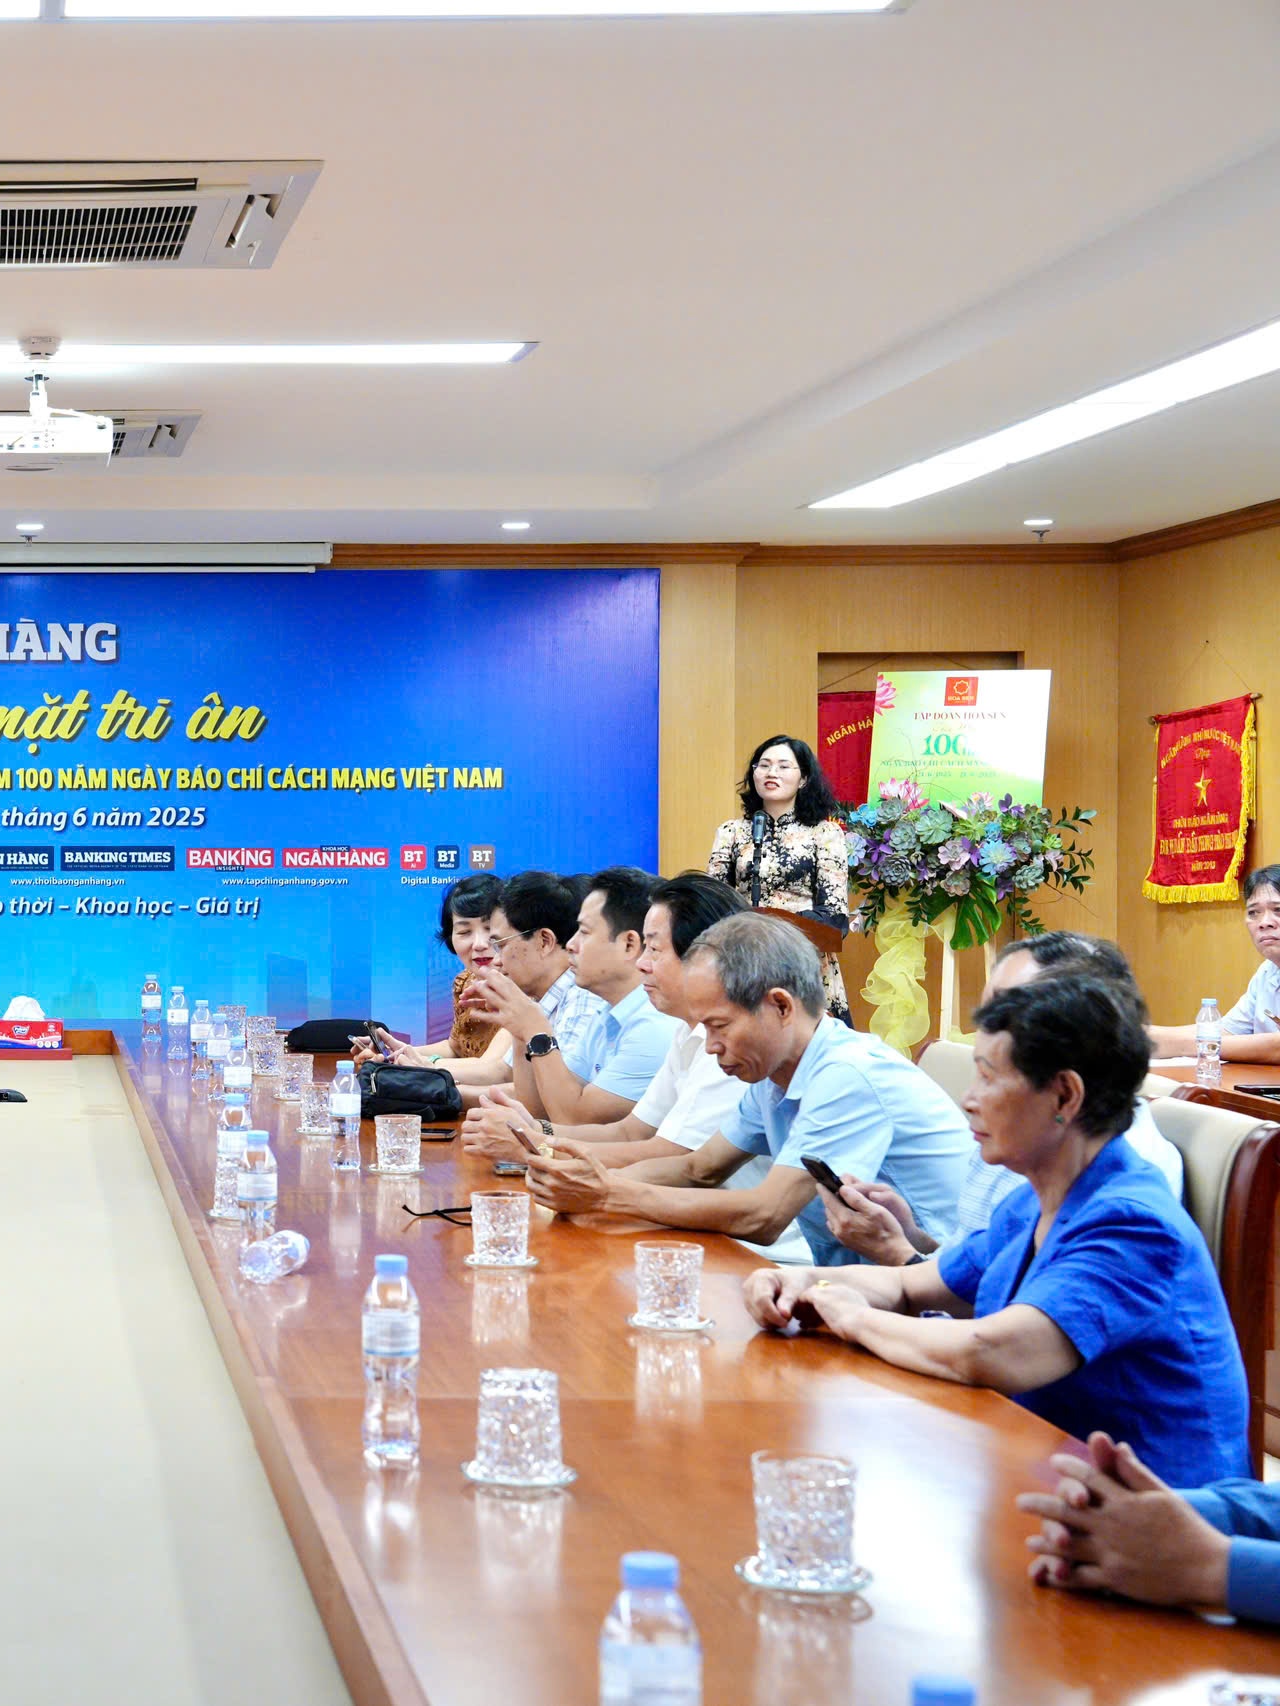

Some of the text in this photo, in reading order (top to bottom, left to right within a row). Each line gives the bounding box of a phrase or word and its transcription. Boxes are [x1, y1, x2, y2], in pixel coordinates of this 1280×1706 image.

[185, 692, 268, 740] ân
[826, 725, 857, 745] NGÂN
[16, 768, 53, 789] 100
[58, 764, 106, 789] NĂM
[112, 764, 171, 789] NGÀY
[176, 764, 221, 789] BÁO
[226, 764, 264, 789] CHÍ
[268, 764, 326, 789] CÁCH
[332, 768, 396, 793] MẠNG
[401, 763, 448, 793] VIỆT
[453, 768, 502, 788] NAM
[1, 807, 67, 831] tháng
[72, 807, 87, 827] 6
[92, 808, 142, 826] năm
[147, 807, 206, 827] 2025
[7, 851, 49, 865] HÀNG
[64, 852, 171, 863] BANKING TIMES
[285, 849, 386, 866] NGÂN HÀNG
[404, 850, 424, 862] BT
[437, 850, 457, 862] BT
[472, 850, 492, 862] BT
[222, 876, 349, 886] www.tapchinganhang.gov.vn
[401, 876, 429, 886] Digital
[10, 896, 53, 914] thời
[75, 897, 129, 914] Khoa
[135, 897, 173, 919] học
[196, 897, 230, 914] Giá
[235, 897, 260, 919] trị
